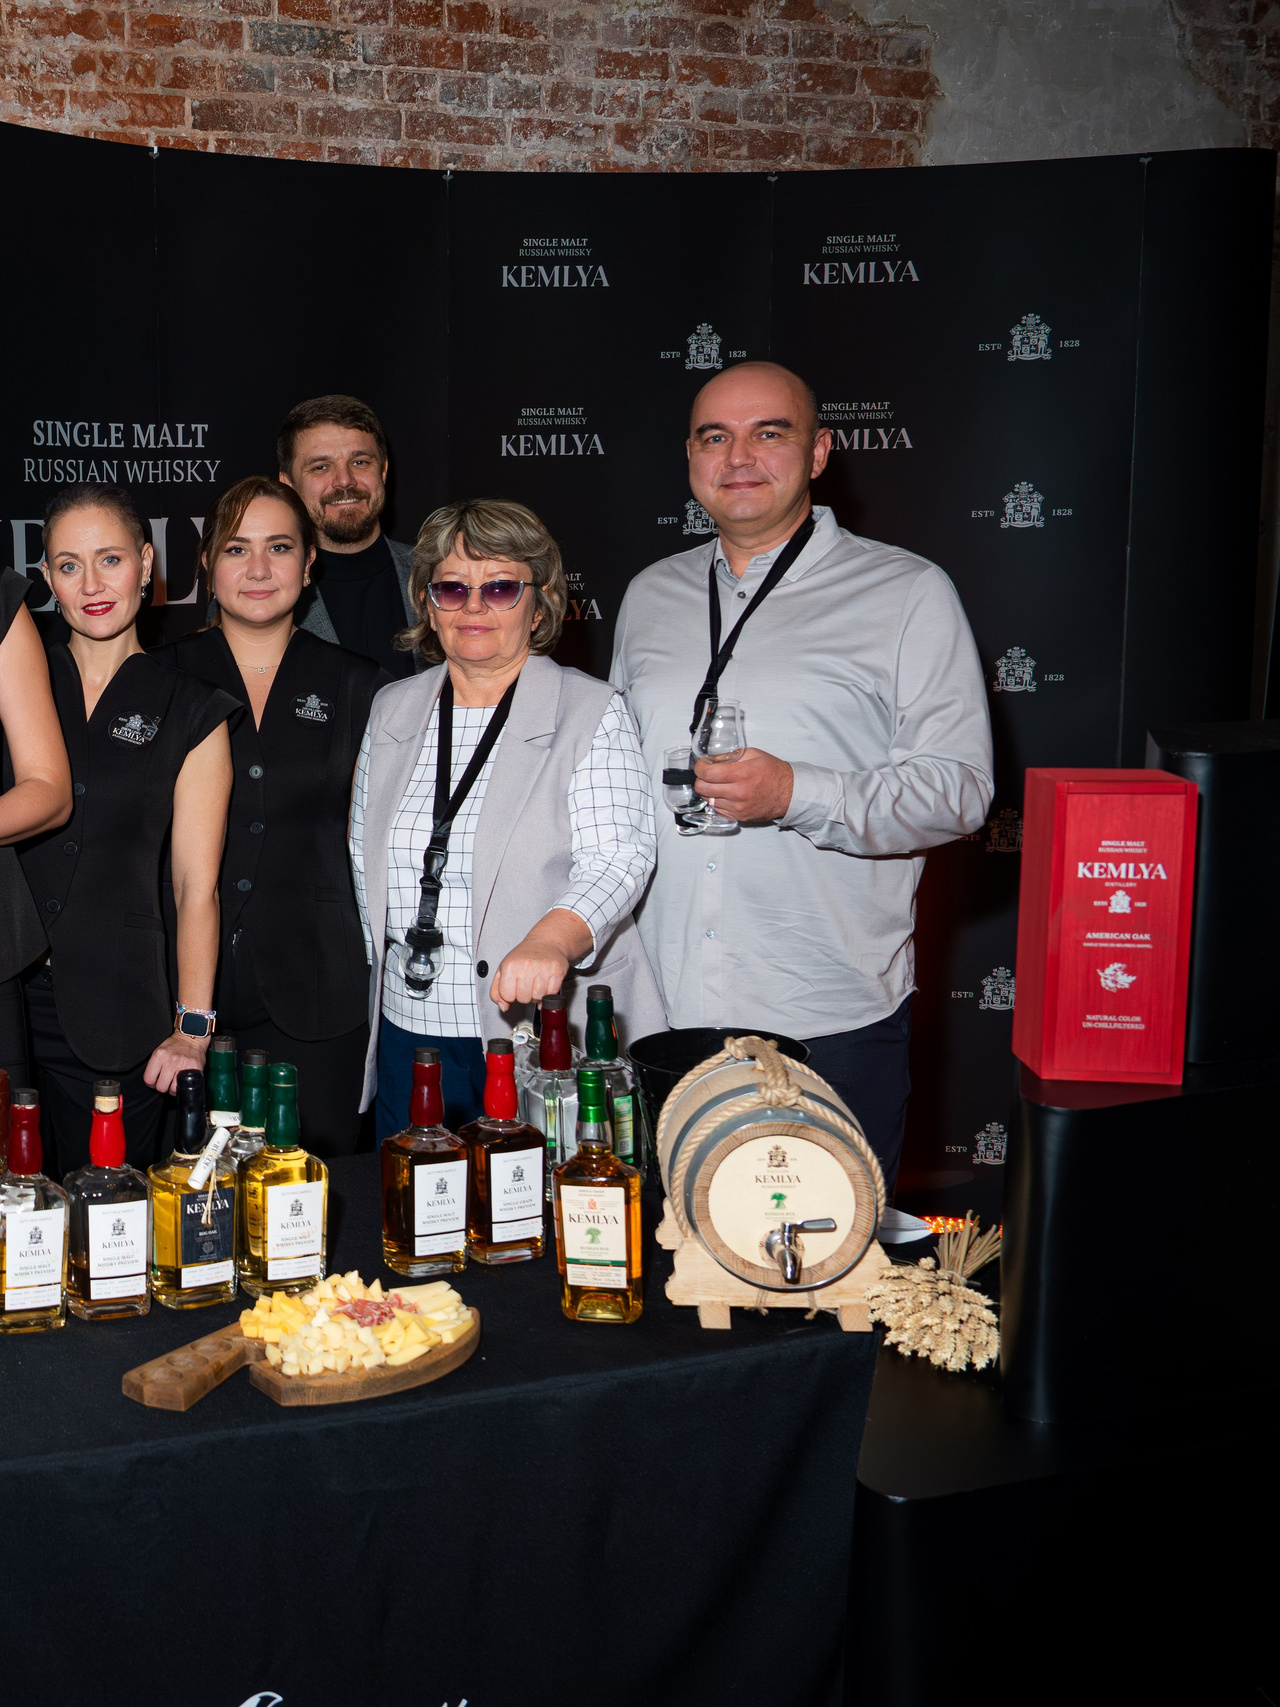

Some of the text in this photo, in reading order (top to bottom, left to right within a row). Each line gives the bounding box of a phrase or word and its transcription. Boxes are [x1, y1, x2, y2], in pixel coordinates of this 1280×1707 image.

[523, 238, 588, 247] SINGLE MALT
[826, 233, 897, 244] SINGLE MALT
[519, 248, 592, 257] RUSSIAN WHISKY
[822, 243, 901, 254] RUSSIAN WHISKY
[502, 265, 610, 288] KEMLYA
[803, 260, 920, 285] KEMLYA
[1058, 339, 1080, 348] 1828
[728, 350, 747, 358] 1828
[821, 401, 890, 411] SINGLE MALT
[521, 407, 584, 416] SINGLE MALT
[818, 411, 894, 421] RUSSIAN WHISKY
[517, 417, 587, 426] RUSSIAN WHISKY
[33, 419, 209, 449] SINGLE MALT
[500, 433, 605, 457] KEMLYA
[23, 458, 221, 483] RUSSIAN WHISKY
[1051, 508, 1073, 517] 1828
[1043, 674, 1065, 682] 1828
[295, 707, 328, 720] KEMLYA
[1077, 862, 1168, 880] KEMLYA
[1085, 932, 1151, 941] AMERICAN OAK
[755, 1175, 801, 1184] KEMLYA
[503, 1185, 533, 1195] KEMLYA
[426, 1198, 456, 1208] KEMLYA
[568, 1213, 619, 1225] KEMLYA
[280, 1220, 311, 1230] KEMLYA
[102, 1239, 135, 1249] KEMLYA
[19, 1248, 52, 1258] KEMLYA
